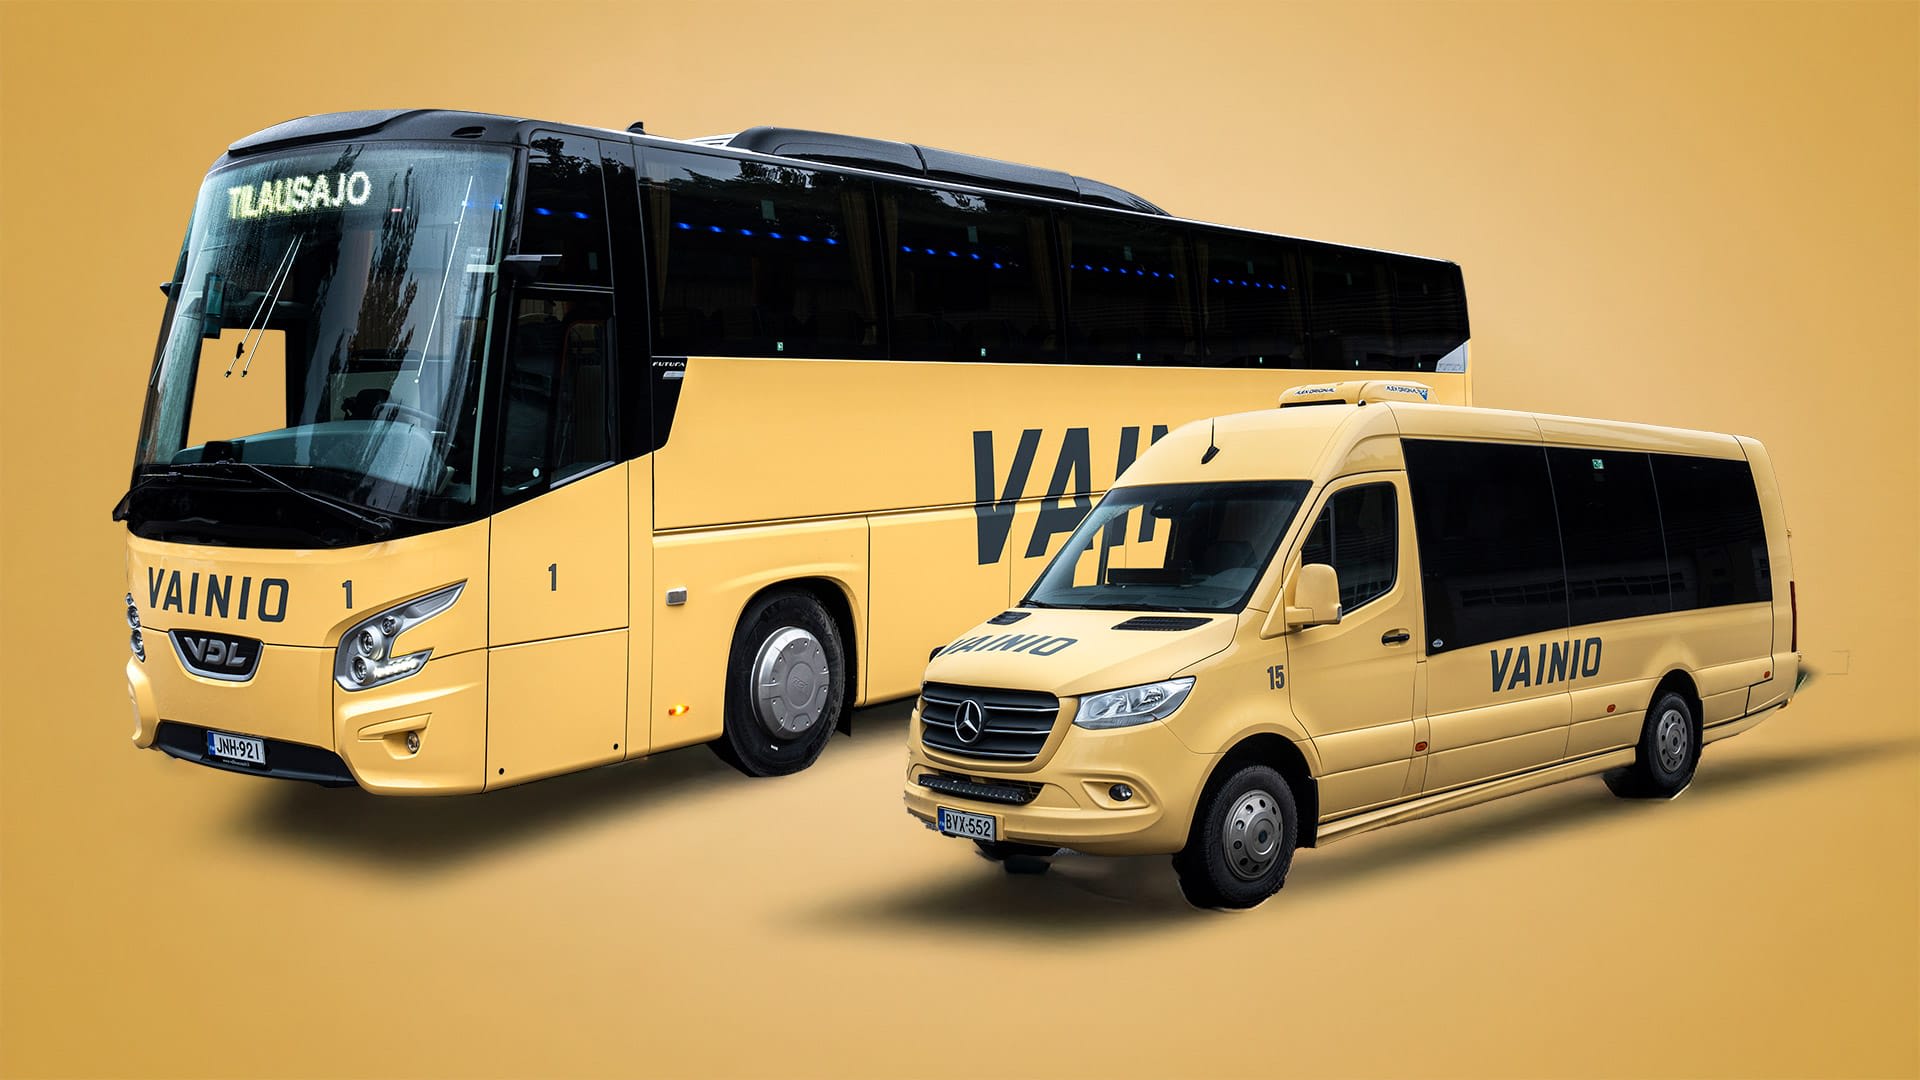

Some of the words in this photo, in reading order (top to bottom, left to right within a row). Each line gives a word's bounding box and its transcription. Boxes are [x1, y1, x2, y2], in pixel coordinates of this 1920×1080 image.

[228, 171, 371, 219] TILAUSAJO
[548, 563, 557, 591] 1
[148, 567, 289, 622] VAINIO
[342, 580, 353, 609] 1
[184, 636, 247, 667] VDL
[936, 634, 1078, 657] VAINIO
[1267, 665, 1285, 690] 15
[1490, 637, 1602, 692] VAINIO
[216, 737, 260, 760] JNH-921
[945, 813, 991, 837] BVX-552
